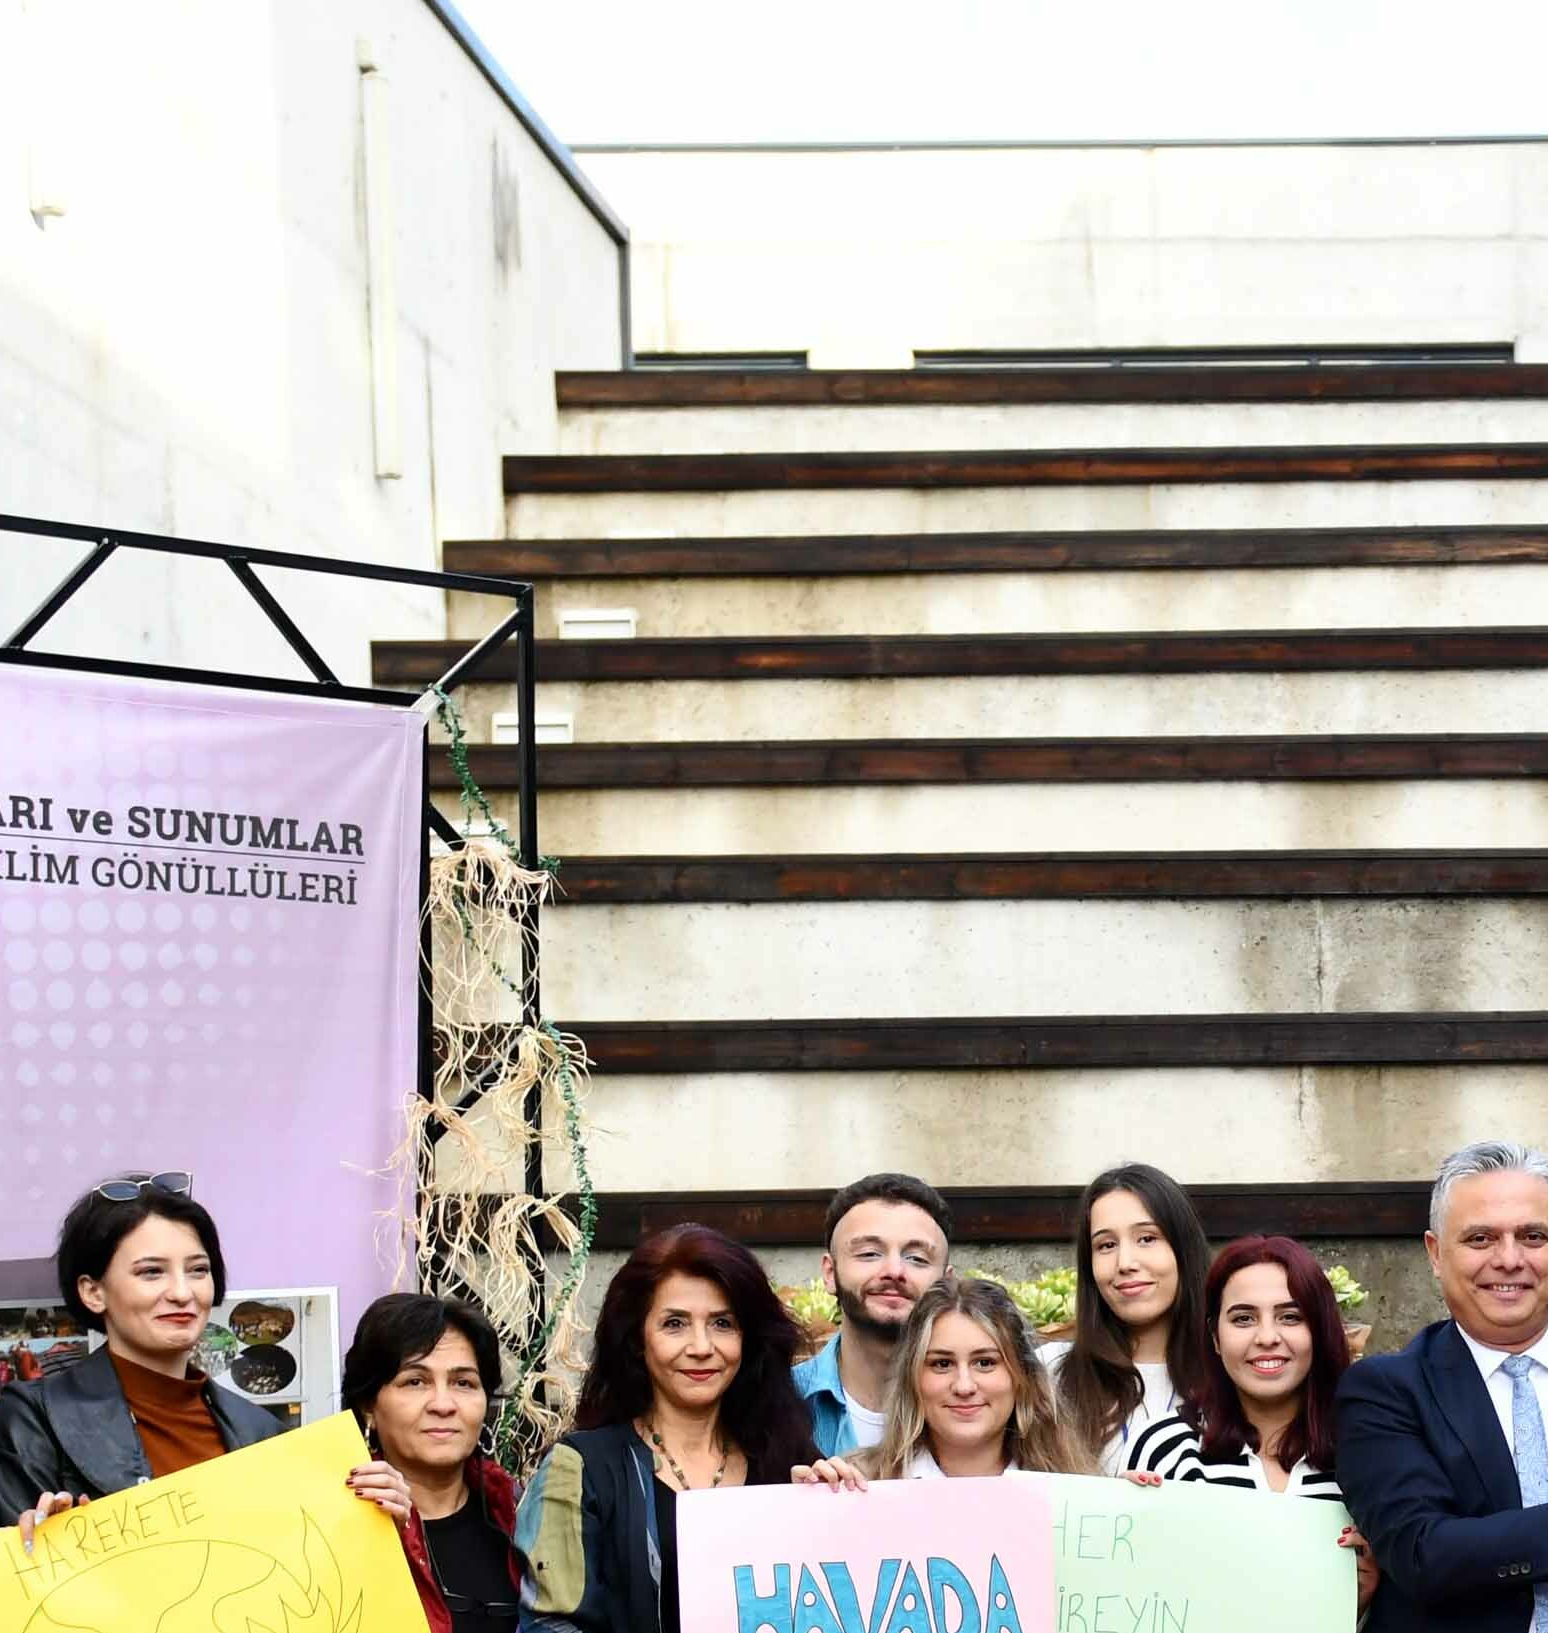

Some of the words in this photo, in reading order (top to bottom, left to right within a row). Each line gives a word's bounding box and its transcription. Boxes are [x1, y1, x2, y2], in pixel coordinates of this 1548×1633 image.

[67, 807, 113, 835] ve
[128, 806, 364, 856] SUNUMLAR
[91, 852, 358, 905] GÖNÜLLÜLERİ
[4, 1490, 204, 1600] HAREKETE
